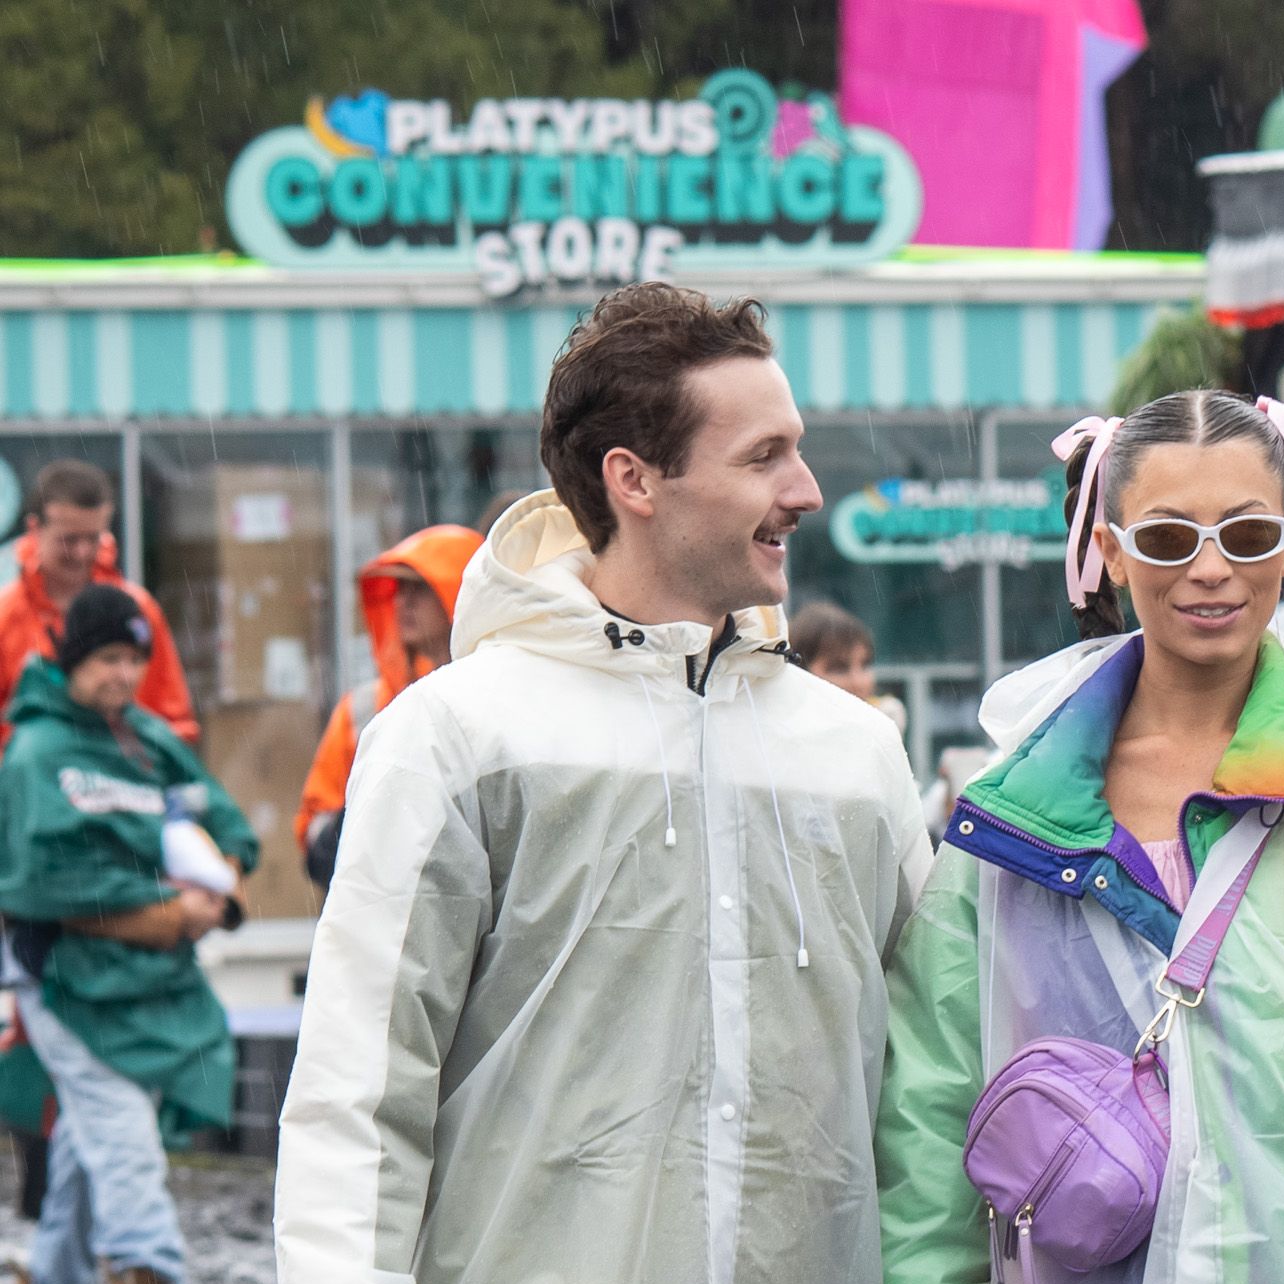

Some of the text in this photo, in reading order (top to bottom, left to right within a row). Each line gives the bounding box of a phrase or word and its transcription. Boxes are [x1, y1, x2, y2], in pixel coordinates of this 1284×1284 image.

[386, 98, 719, 154] PLATYPUS
[264, 156, 886, 226] CONVENIENCE
[474, 217, 684, 298] STORE
